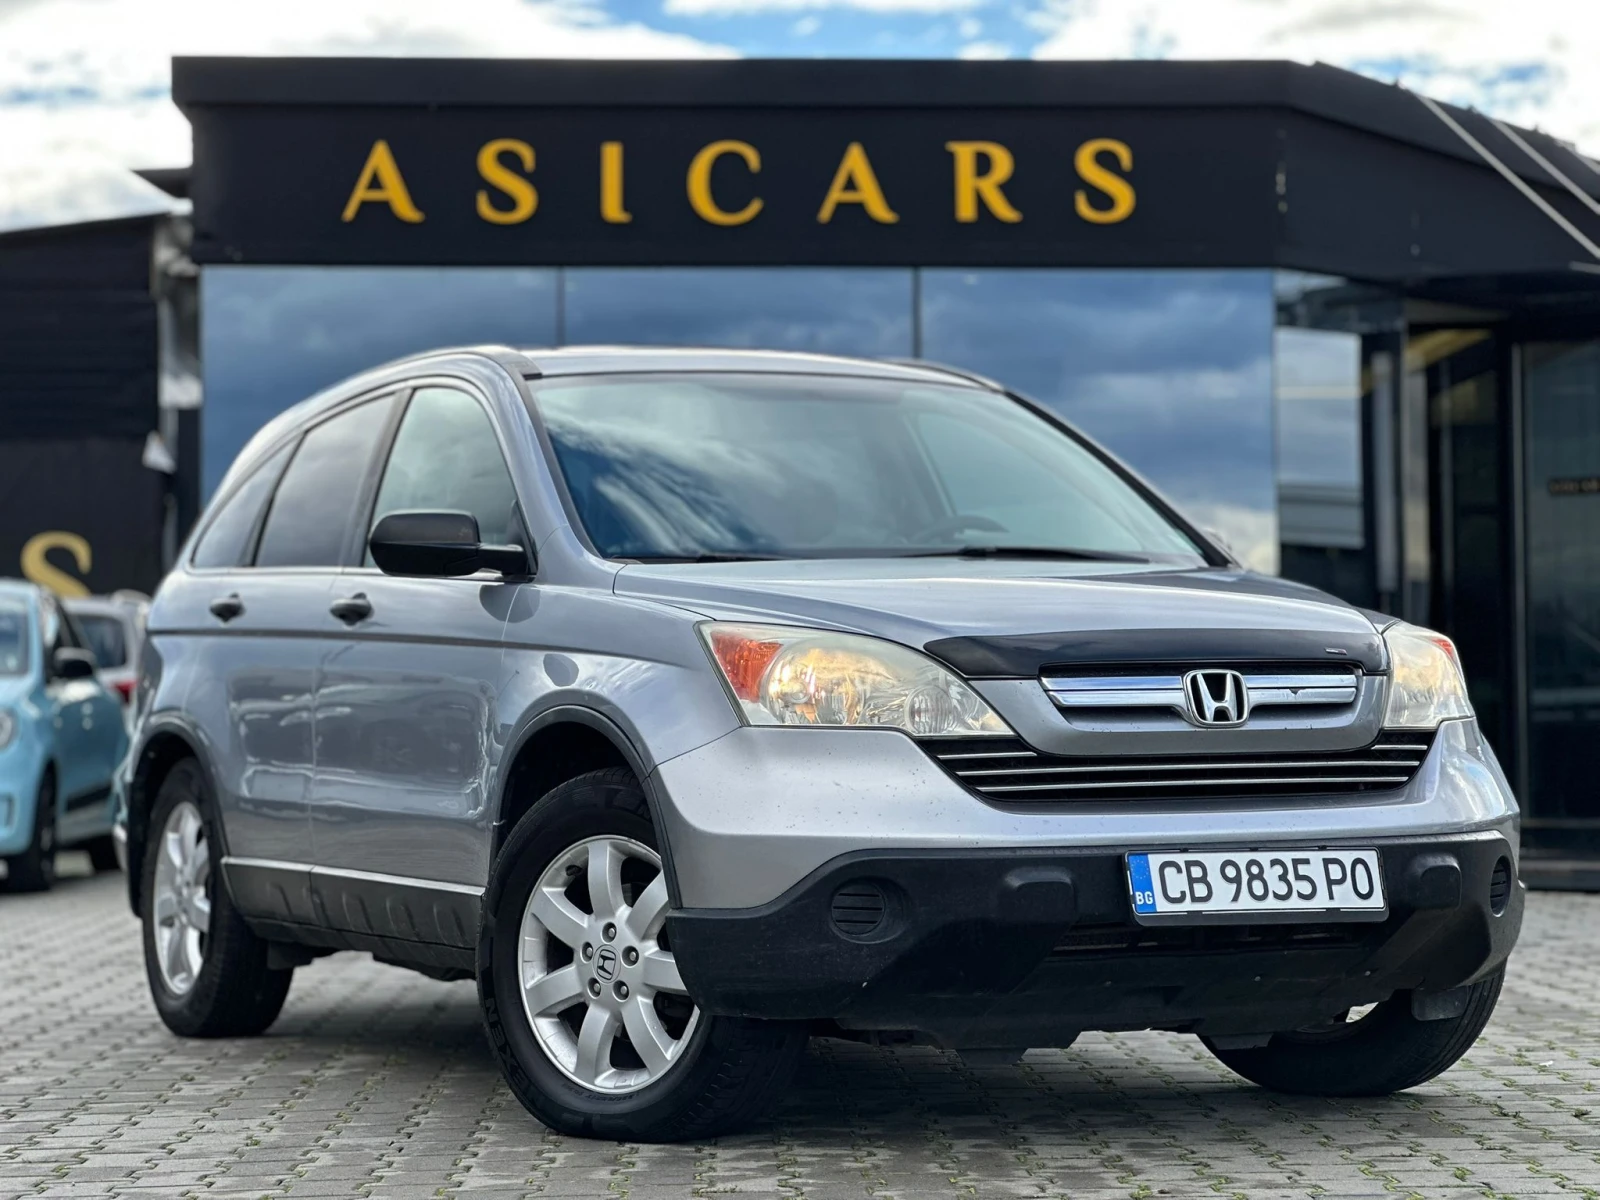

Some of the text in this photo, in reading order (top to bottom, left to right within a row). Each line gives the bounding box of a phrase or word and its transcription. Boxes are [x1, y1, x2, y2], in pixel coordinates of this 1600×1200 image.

[342, 138, 1135, 225] ASICARS
[1135, 891, 1154, 904] BG
[1158, 859, 1213, 904] CB
[1219, 858, 1318, 903] 9835
